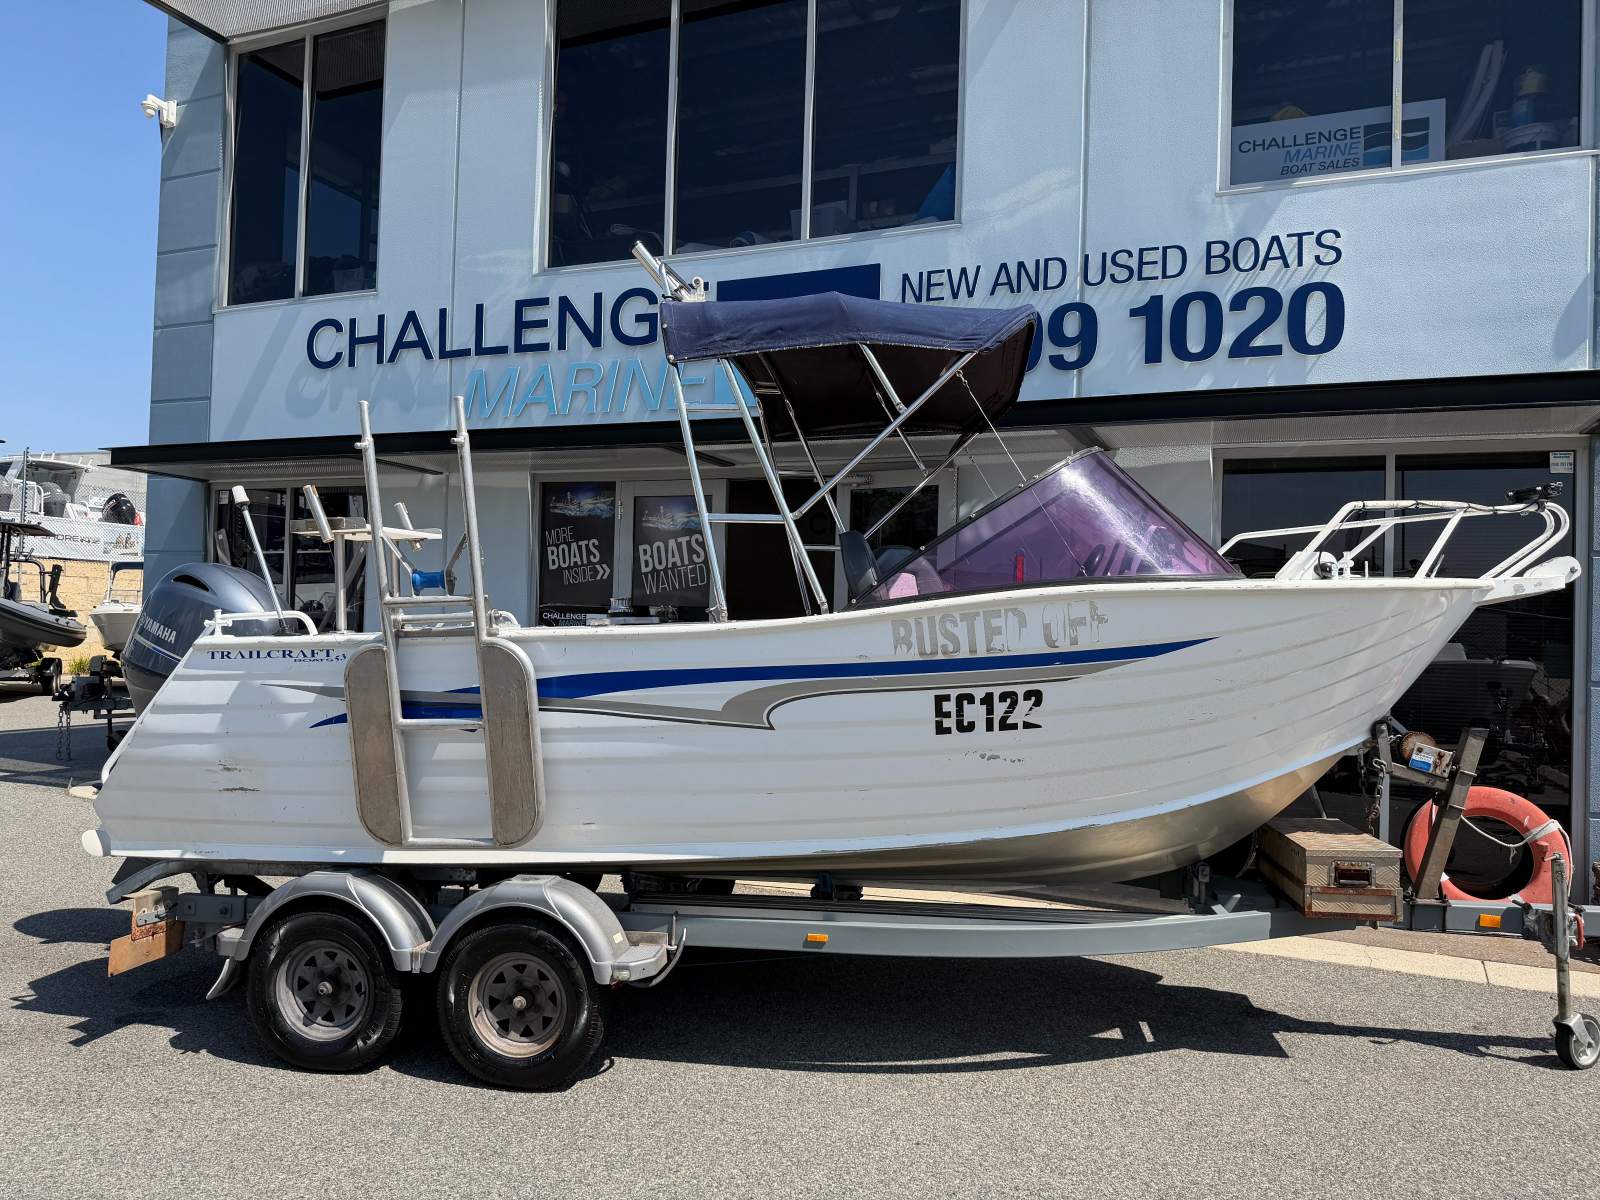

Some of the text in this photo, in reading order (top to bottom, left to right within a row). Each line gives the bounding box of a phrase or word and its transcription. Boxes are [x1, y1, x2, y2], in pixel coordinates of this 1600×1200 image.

[1238, 126, 1362, 154] CHALLENGE
[1283, 140, 1361, 164] MARINE
[1280, 157, 1360, 176] BOAT SALES
[901, 229, 1342, 303] NEW AND USED BOATS
[307, 281, 710, 369] CHALLENG
[1129, 281, 1345, 365] 1020
[545, 525, 575, 545] MORE
[547, 538, 600, 570] BOATS
[638, 533, 705, 573] BOATS
[562, 565, 596, 585] INSIDE
[642, 563, 708, 596] WANTED
[143, 615, 177, 644] YAMAHA
[542, 612, 586, 620] CHALLENGE
[207, 648, 335, 661] TRAILCRAFT
[933, 688, 1044, 736] EC122
